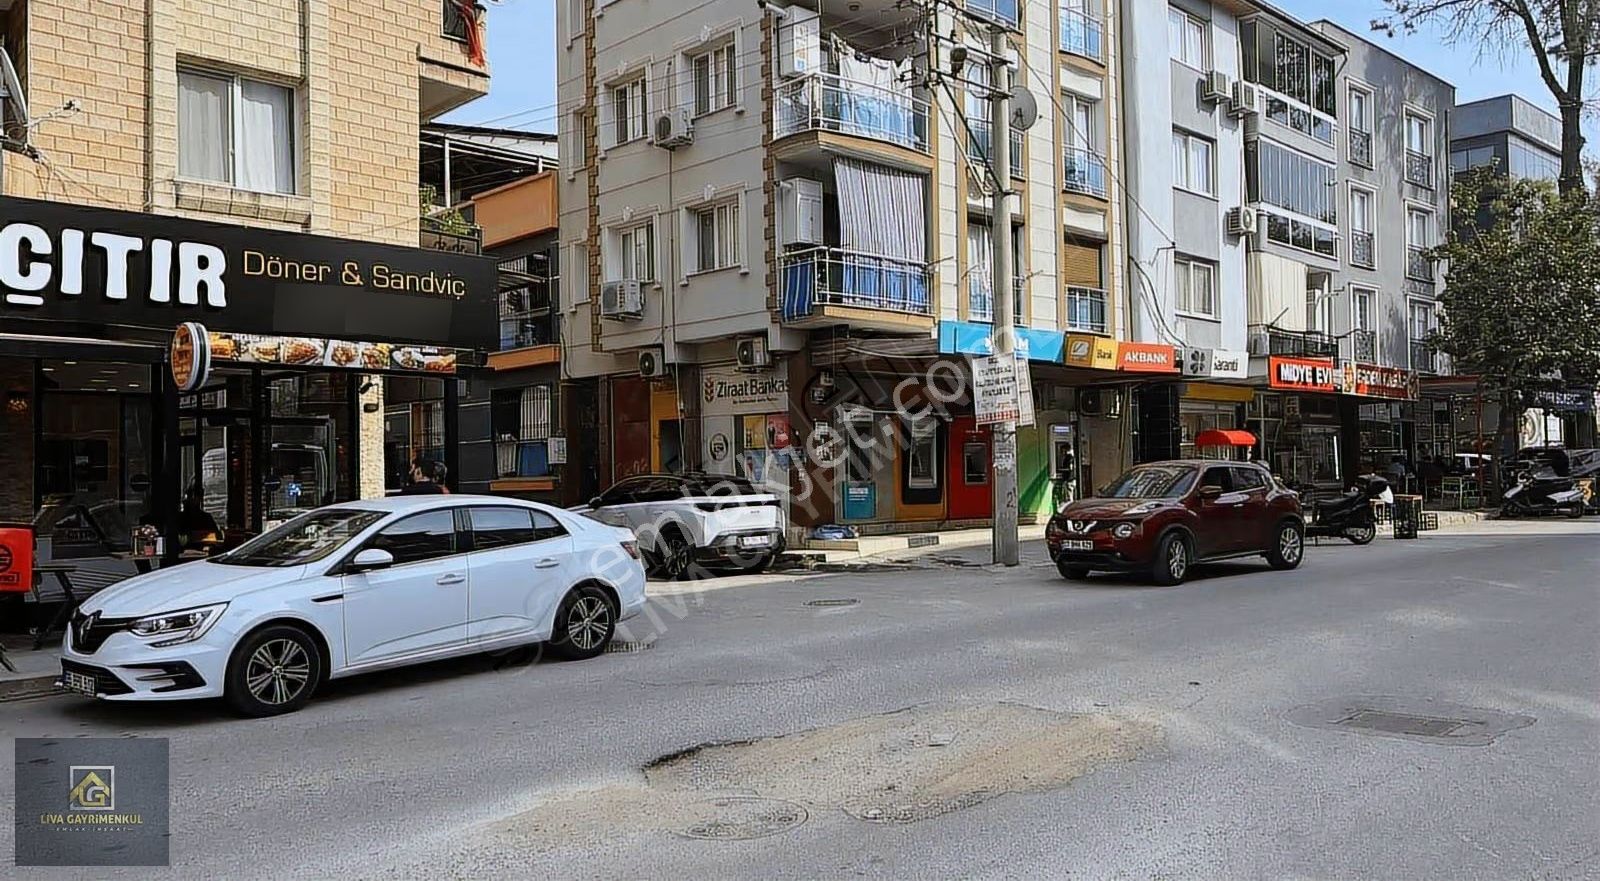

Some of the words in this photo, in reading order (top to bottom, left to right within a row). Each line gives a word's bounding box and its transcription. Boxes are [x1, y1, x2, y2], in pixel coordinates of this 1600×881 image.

[0, 223, 227, 308] ÇITIR
[243, 250, 331, 282] Döner
[341, 262, 364, 286] &
[373, 265, 465, 300] Sandviç
[1124, 350, 1168, 364] AKBANK
[717, 380, 748, 398] Ziraat
